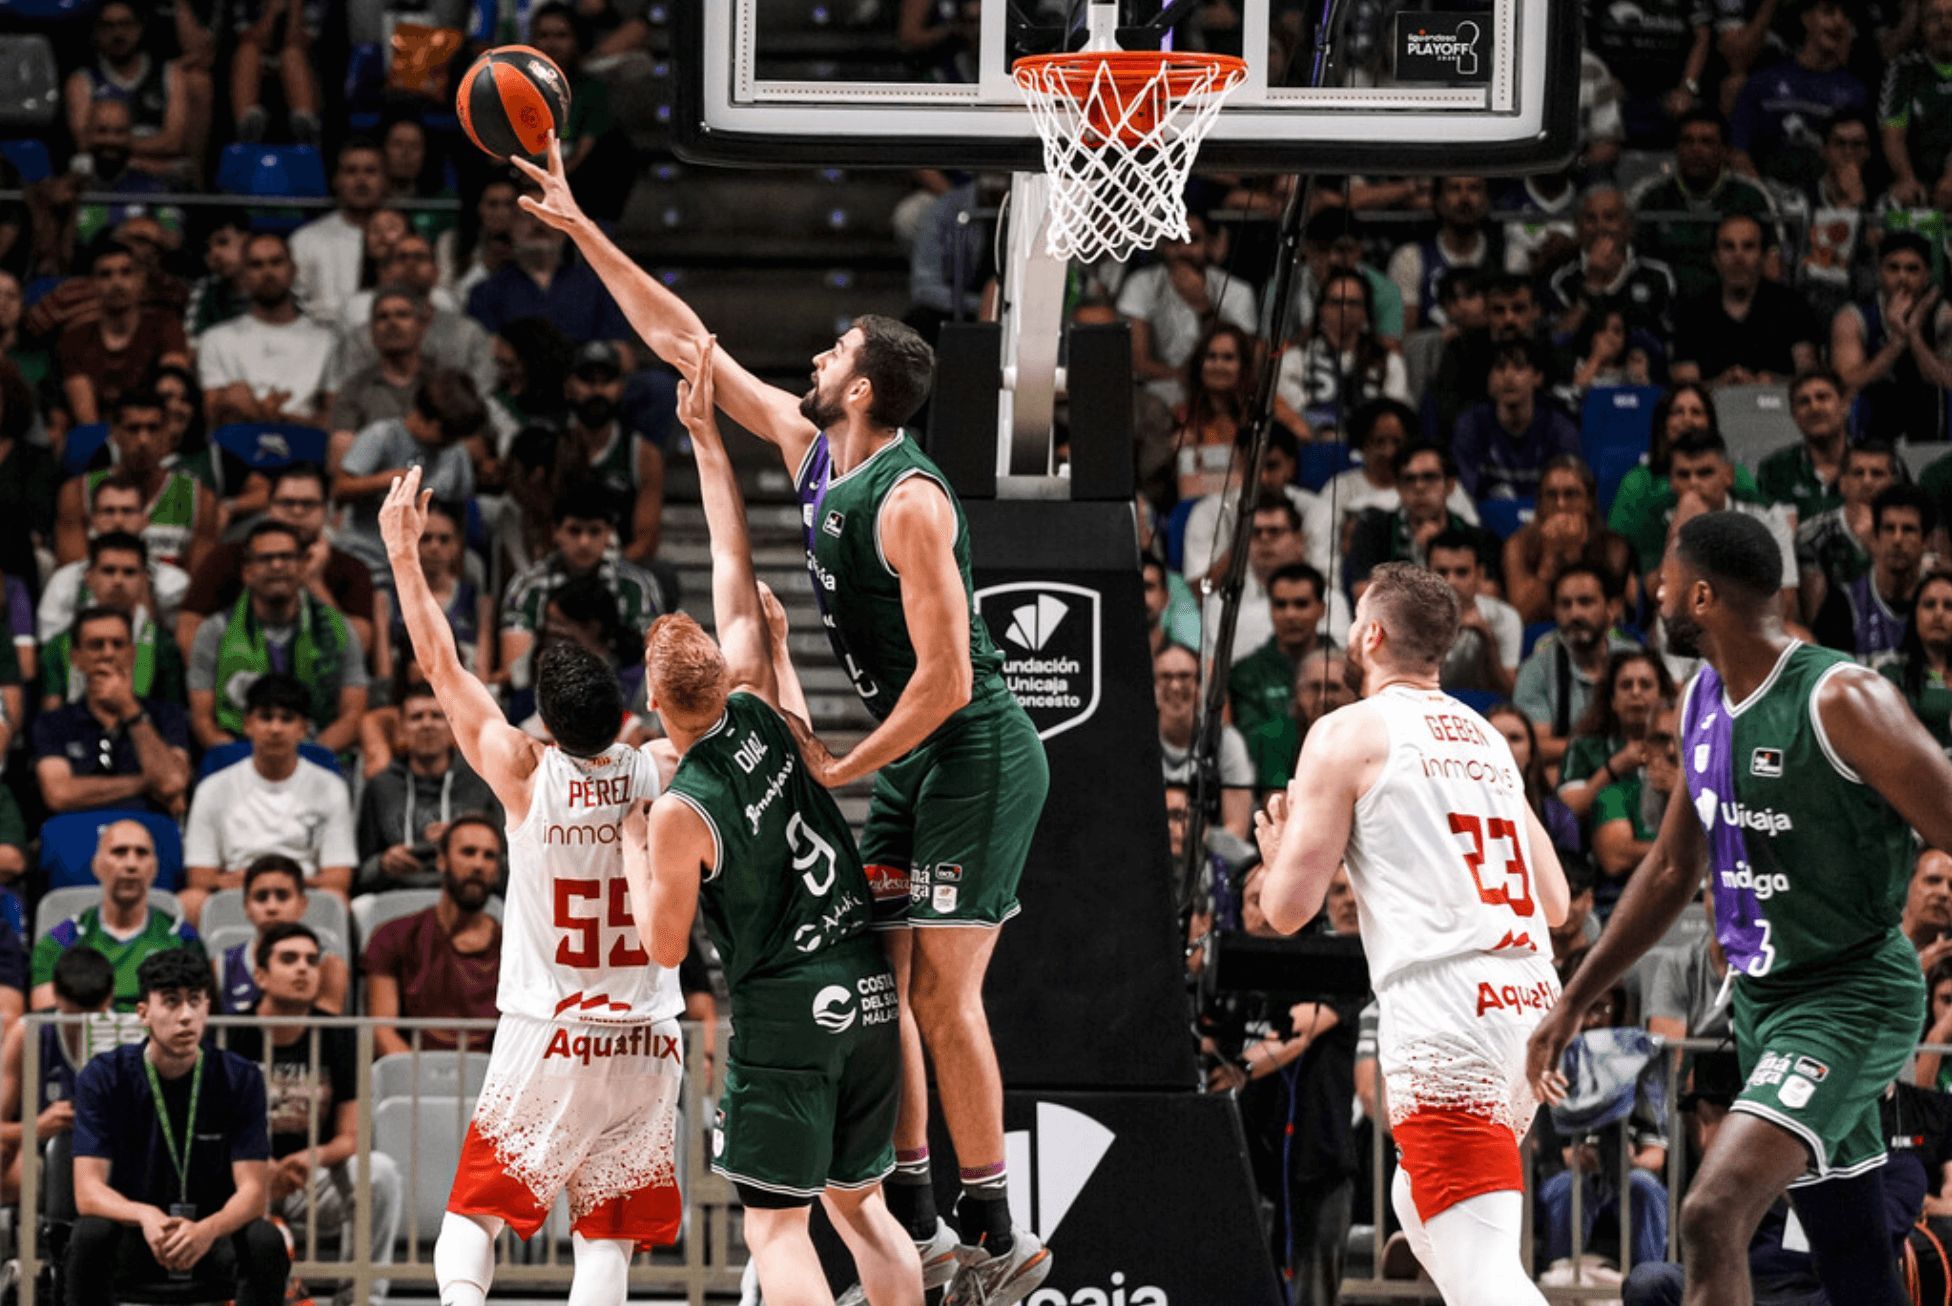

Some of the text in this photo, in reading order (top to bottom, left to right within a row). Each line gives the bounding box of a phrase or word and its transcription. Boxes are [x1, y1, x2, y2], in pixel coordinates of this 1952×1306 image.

[1407, 43, 1470, 56] PLAYOFF
[1003, 657, 1080, 673] undación
[1007, 677, 1068, 695] Unicaja
[1016, 694, 1080, 707] oncesto
[1424, 714, 1490, 748] GEBEN
[569, 776, 631, 808] PÉREZ
[785, 811, 836, 897] 9
[1447, 812, 1535, 918] 23
[554, 877, 651, 969] 55
[1747, 919, 1775, 977] 3
[857, 973, 896, 995] COSTA
[861, 995, 884, 1012] DEL
